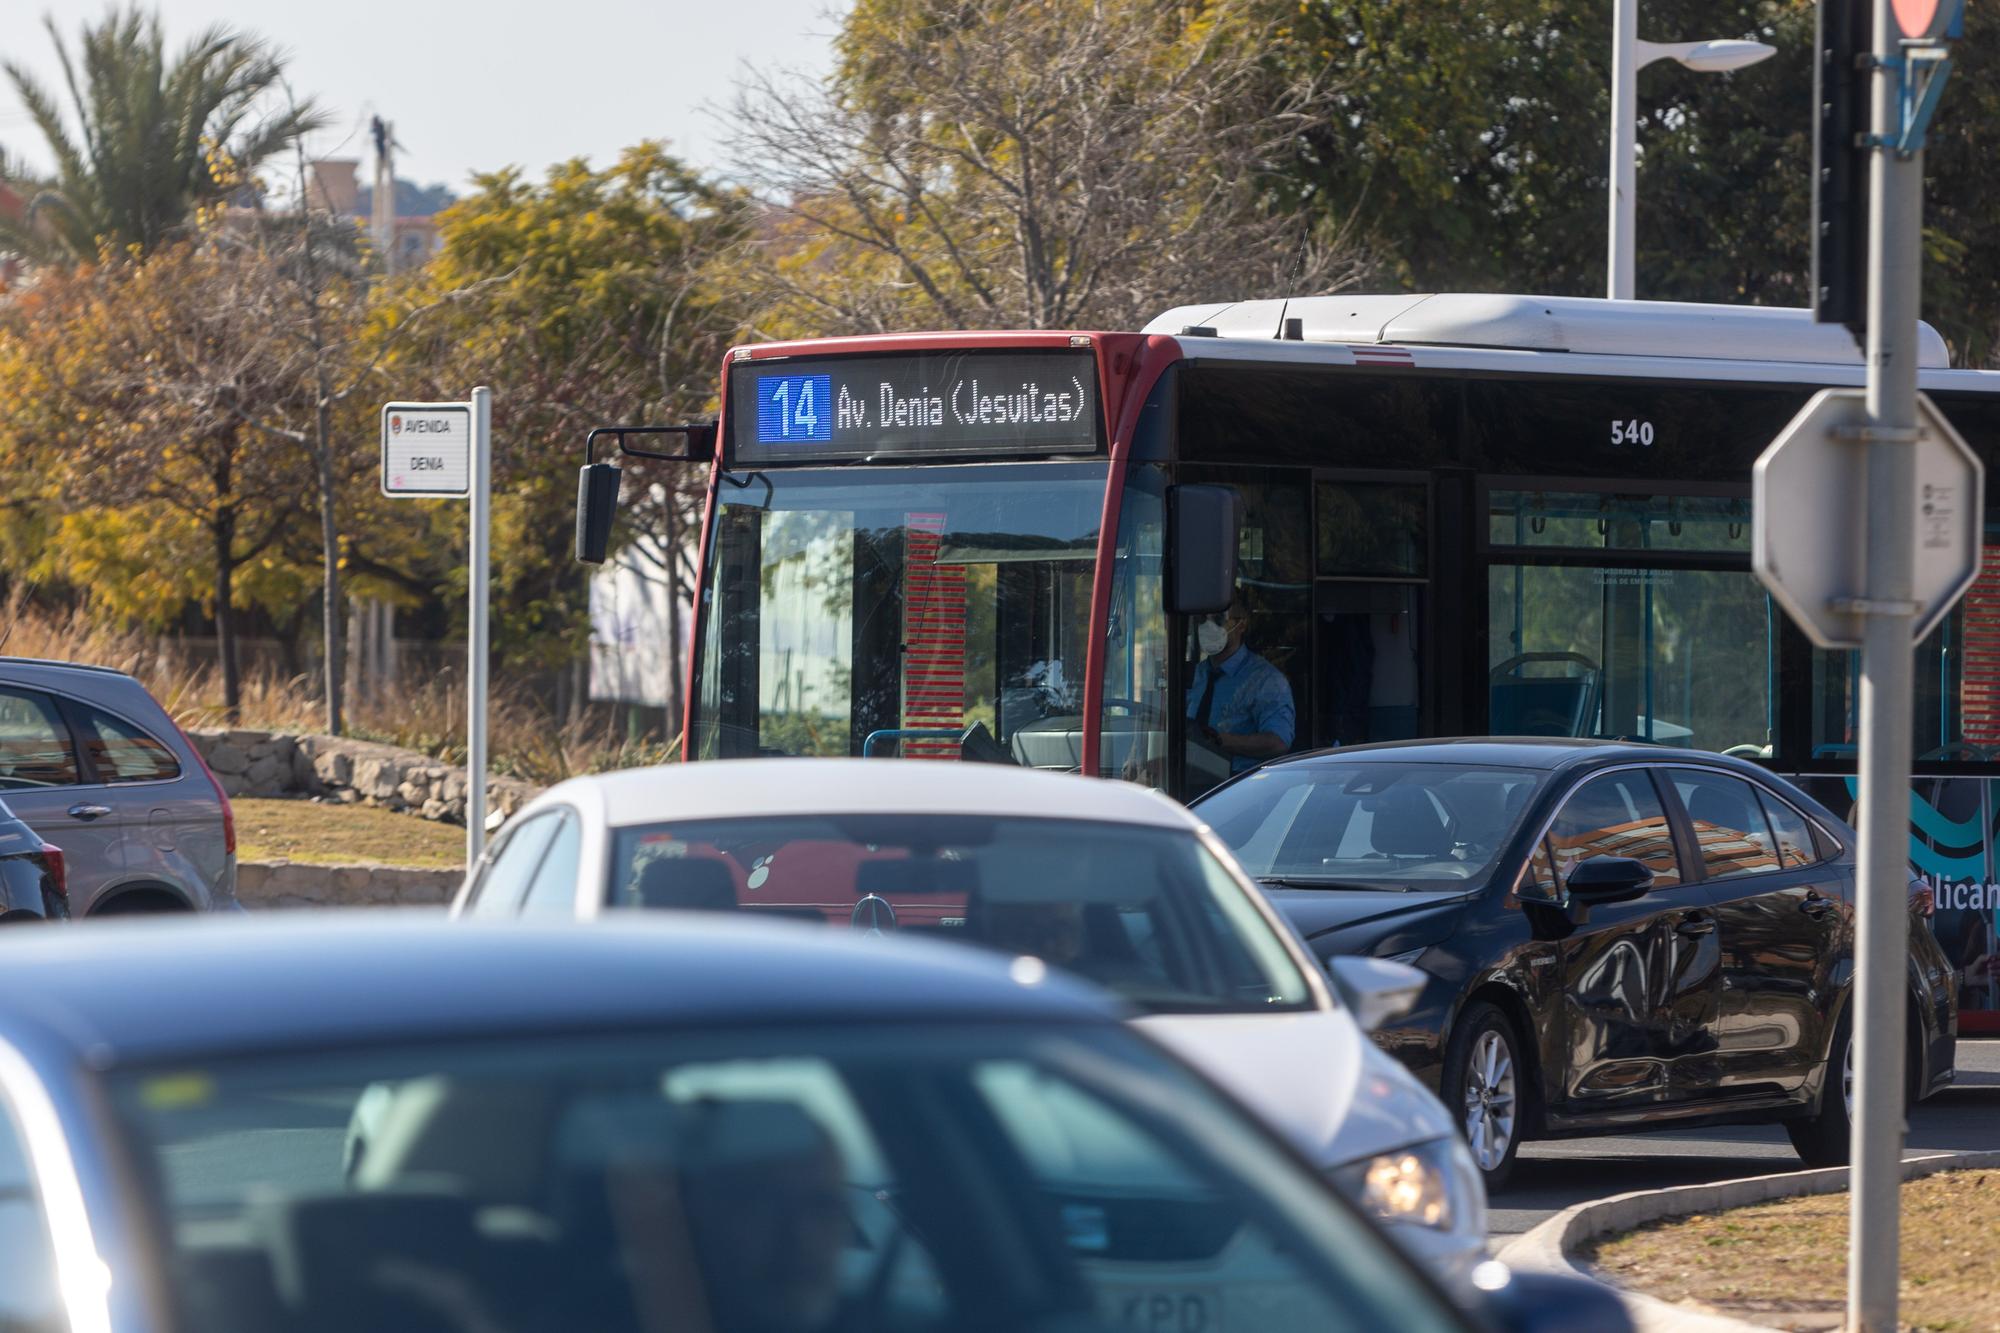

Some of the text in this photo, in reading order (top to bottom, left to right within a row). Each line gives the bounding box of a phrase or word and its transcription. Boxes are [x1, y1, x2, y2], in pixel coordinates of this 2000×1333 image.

[772, 375, 1085, 437] 14 Av. Denia (Jesuitas)
[405, 420, 451, 433] AVENIDA
[1611, 419, 1654, 446] 540
[411, 457, 444, 470] DENIA
